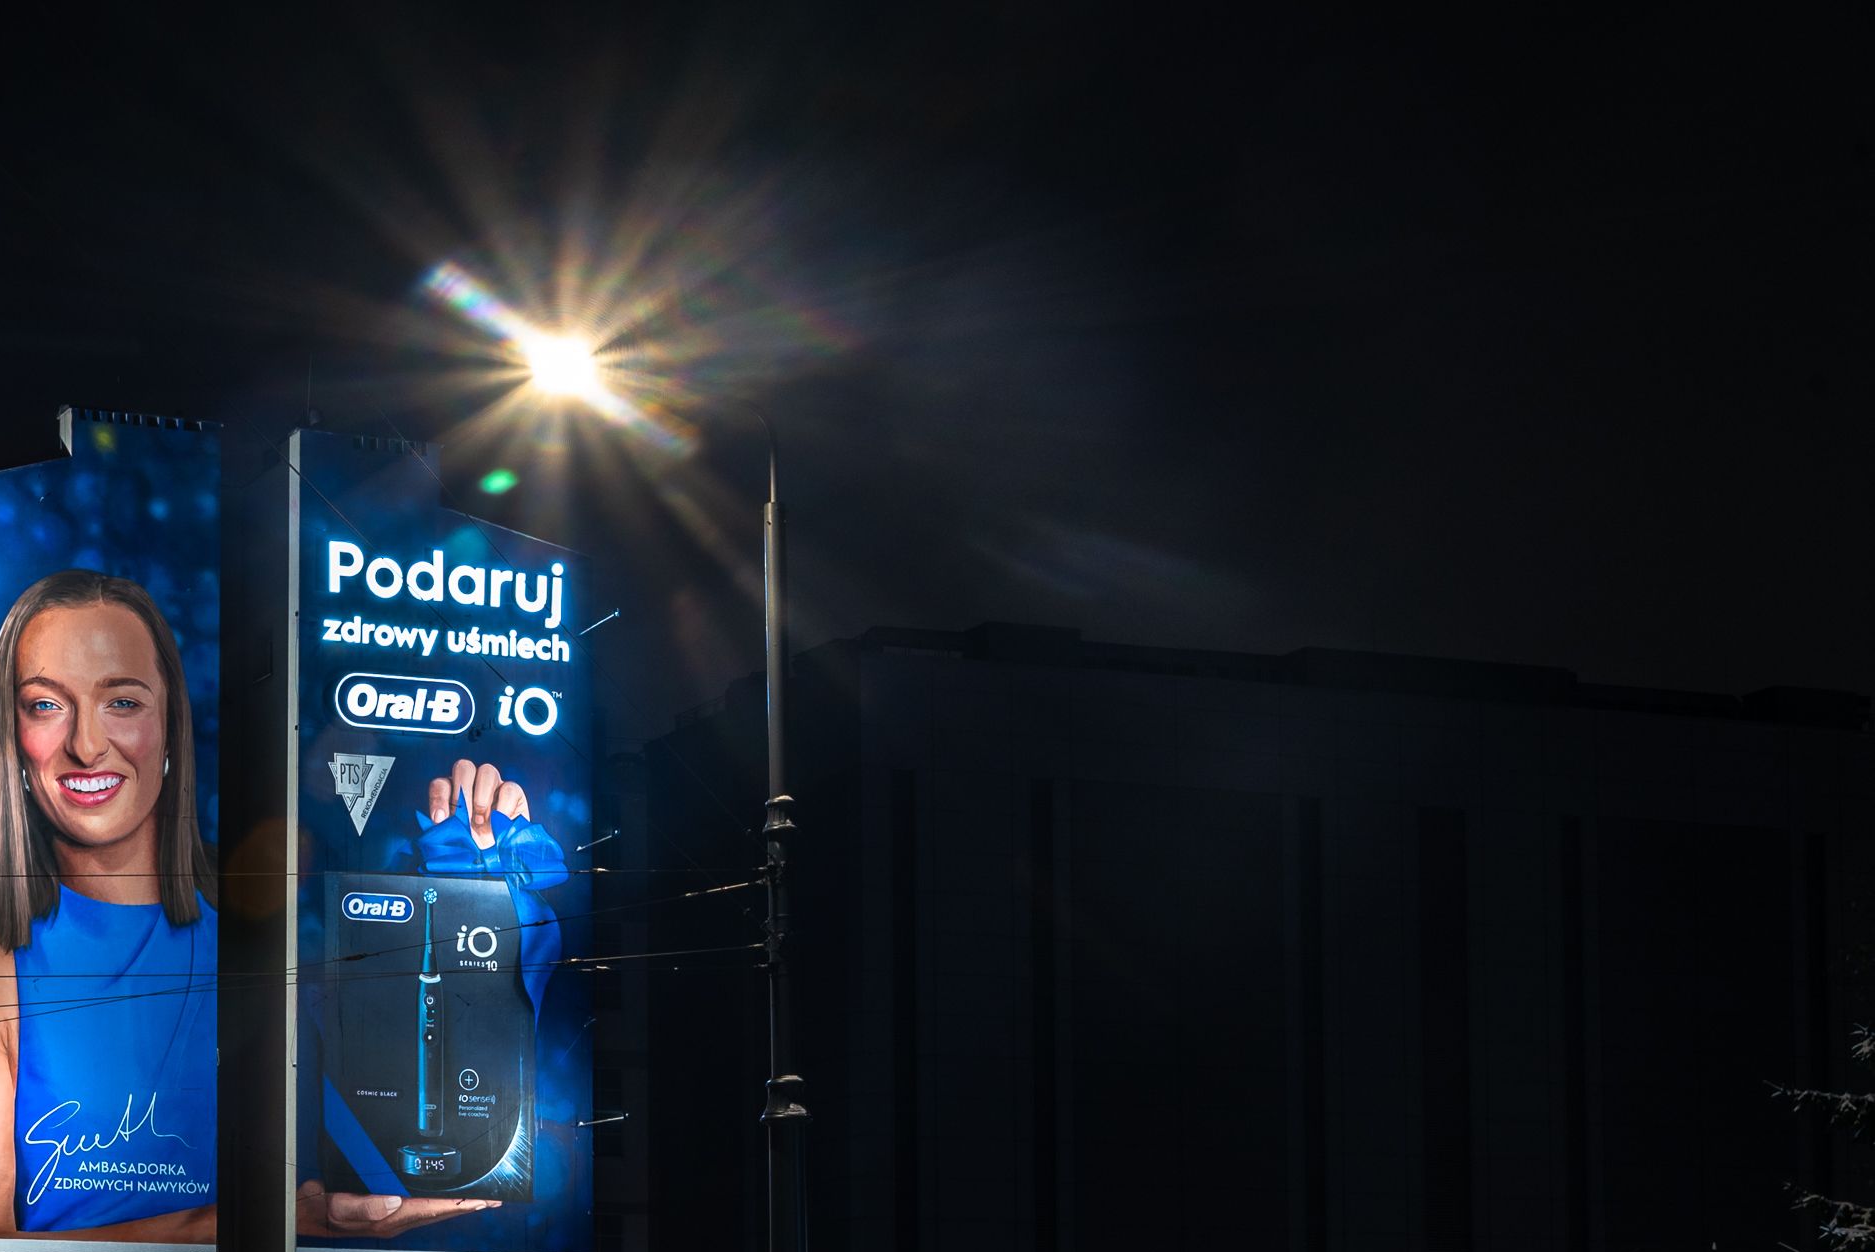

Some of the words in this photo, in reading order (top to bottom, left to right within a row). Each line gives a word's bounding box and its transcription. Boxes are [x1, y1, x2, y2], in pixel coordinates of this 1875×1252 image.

[328, 540, 564, 628] Podaruj
[323, 616, 438, 656] zdrowy
[447, 626, 570, 662] uśmiech
[346, 683, 461, 722] Oral-B
[339, 763, 360, 785] PTS
[361, 768, 388, 819] REKOMENDACJA
[348, 898, 406, 917] Oral-B
[78, 1160, 187, 1177] AMBASADORKA
[54, 1177, 133, 1192] ZDROWYCH
[137, 1178, 210, 1194] NAWYKÓW
